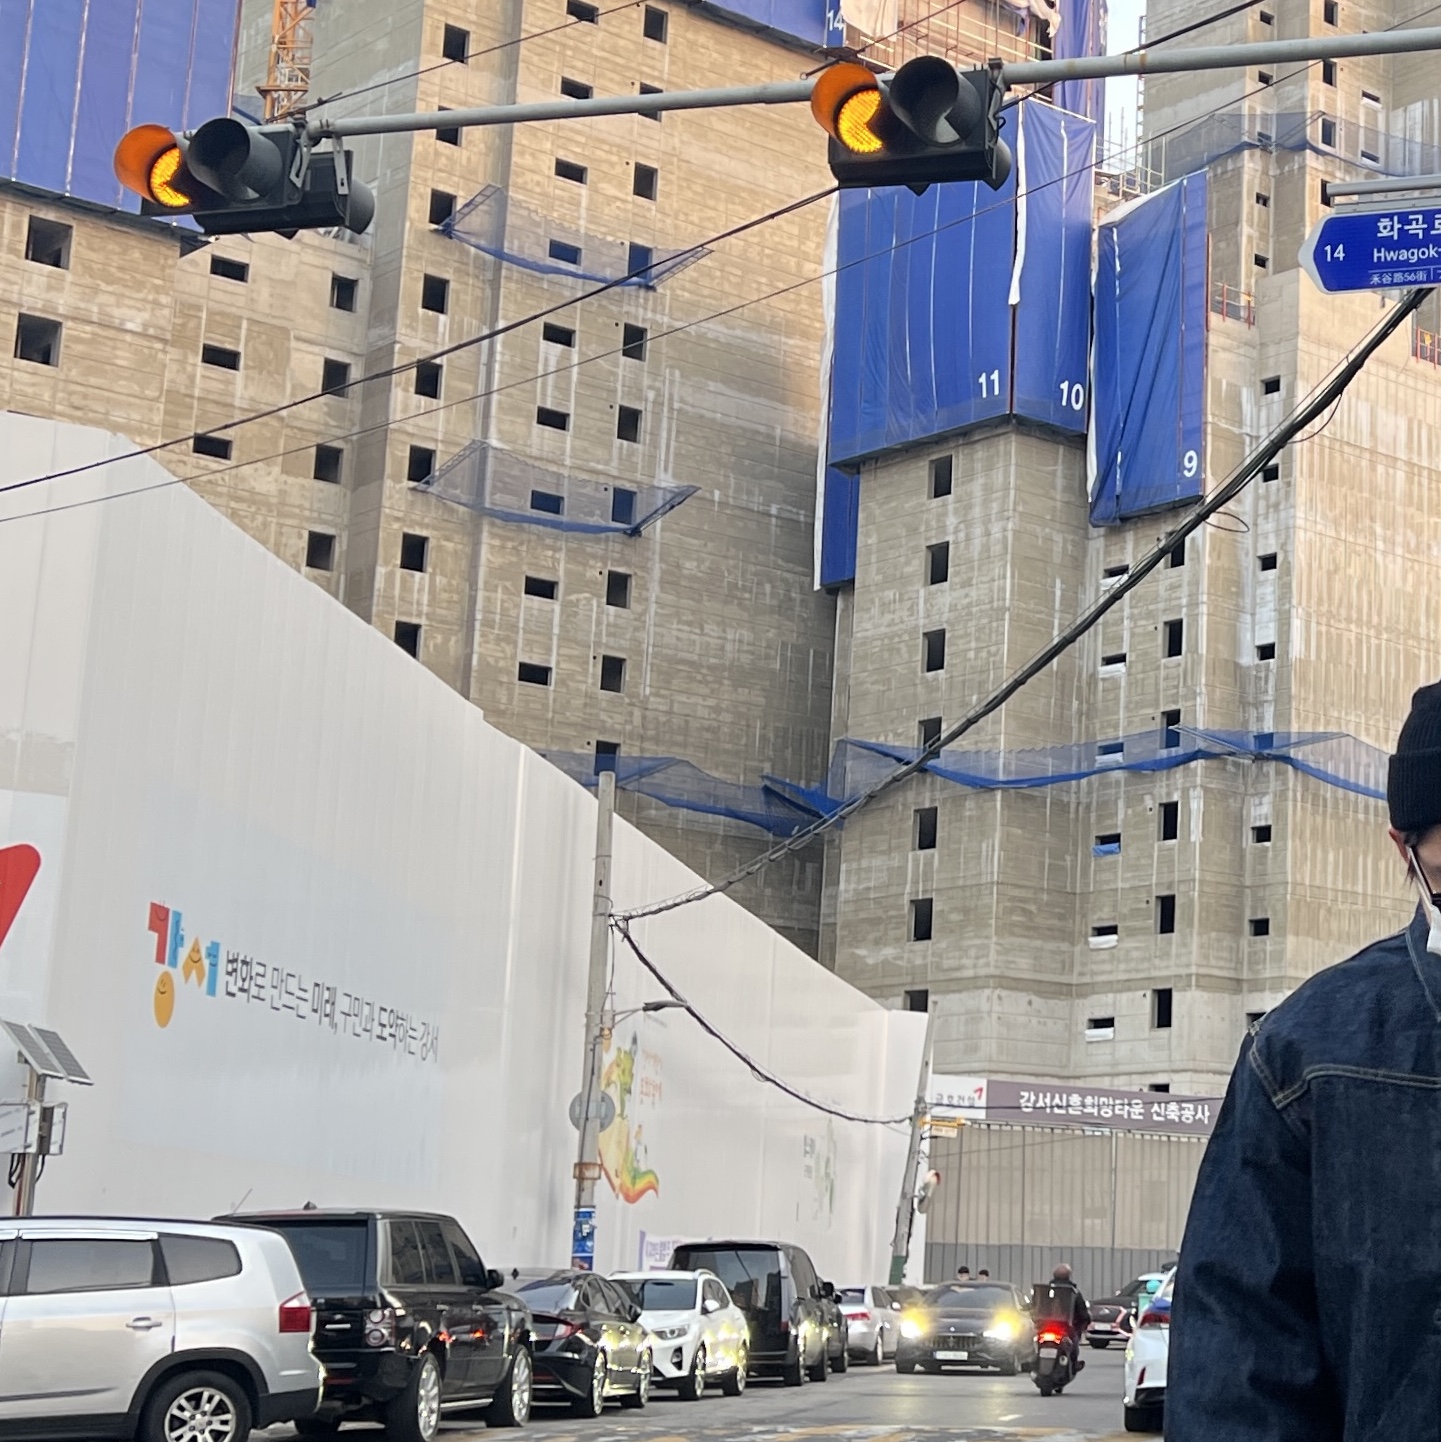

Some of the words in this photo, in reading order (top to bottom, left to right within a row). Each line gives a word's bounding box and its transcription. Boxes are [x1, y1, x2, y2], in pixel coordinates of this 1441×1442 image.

[827, 10, 845, 31] 14
[1324, 243, 1346, 262] 14
[978, 369, 1000, 399] 11
[1060, 380, 1084, 411] 10
[1183, 450, 1198, 478] 9
[225, 950, 266, 1003] 변화로
[270, 967, 309, 1020] 만드는
[311, 982, 337, 1035] 미래,
[340, 992, 375, 1042] 구민과
[376, 1006, 418, 1055] 도약하는
[419, 1021, 439, 1063] 강서
[1019, 1091, 1145, 1120] 강서신혼희망타운
[1151, 1101, 1210, 1124] 신축공사
